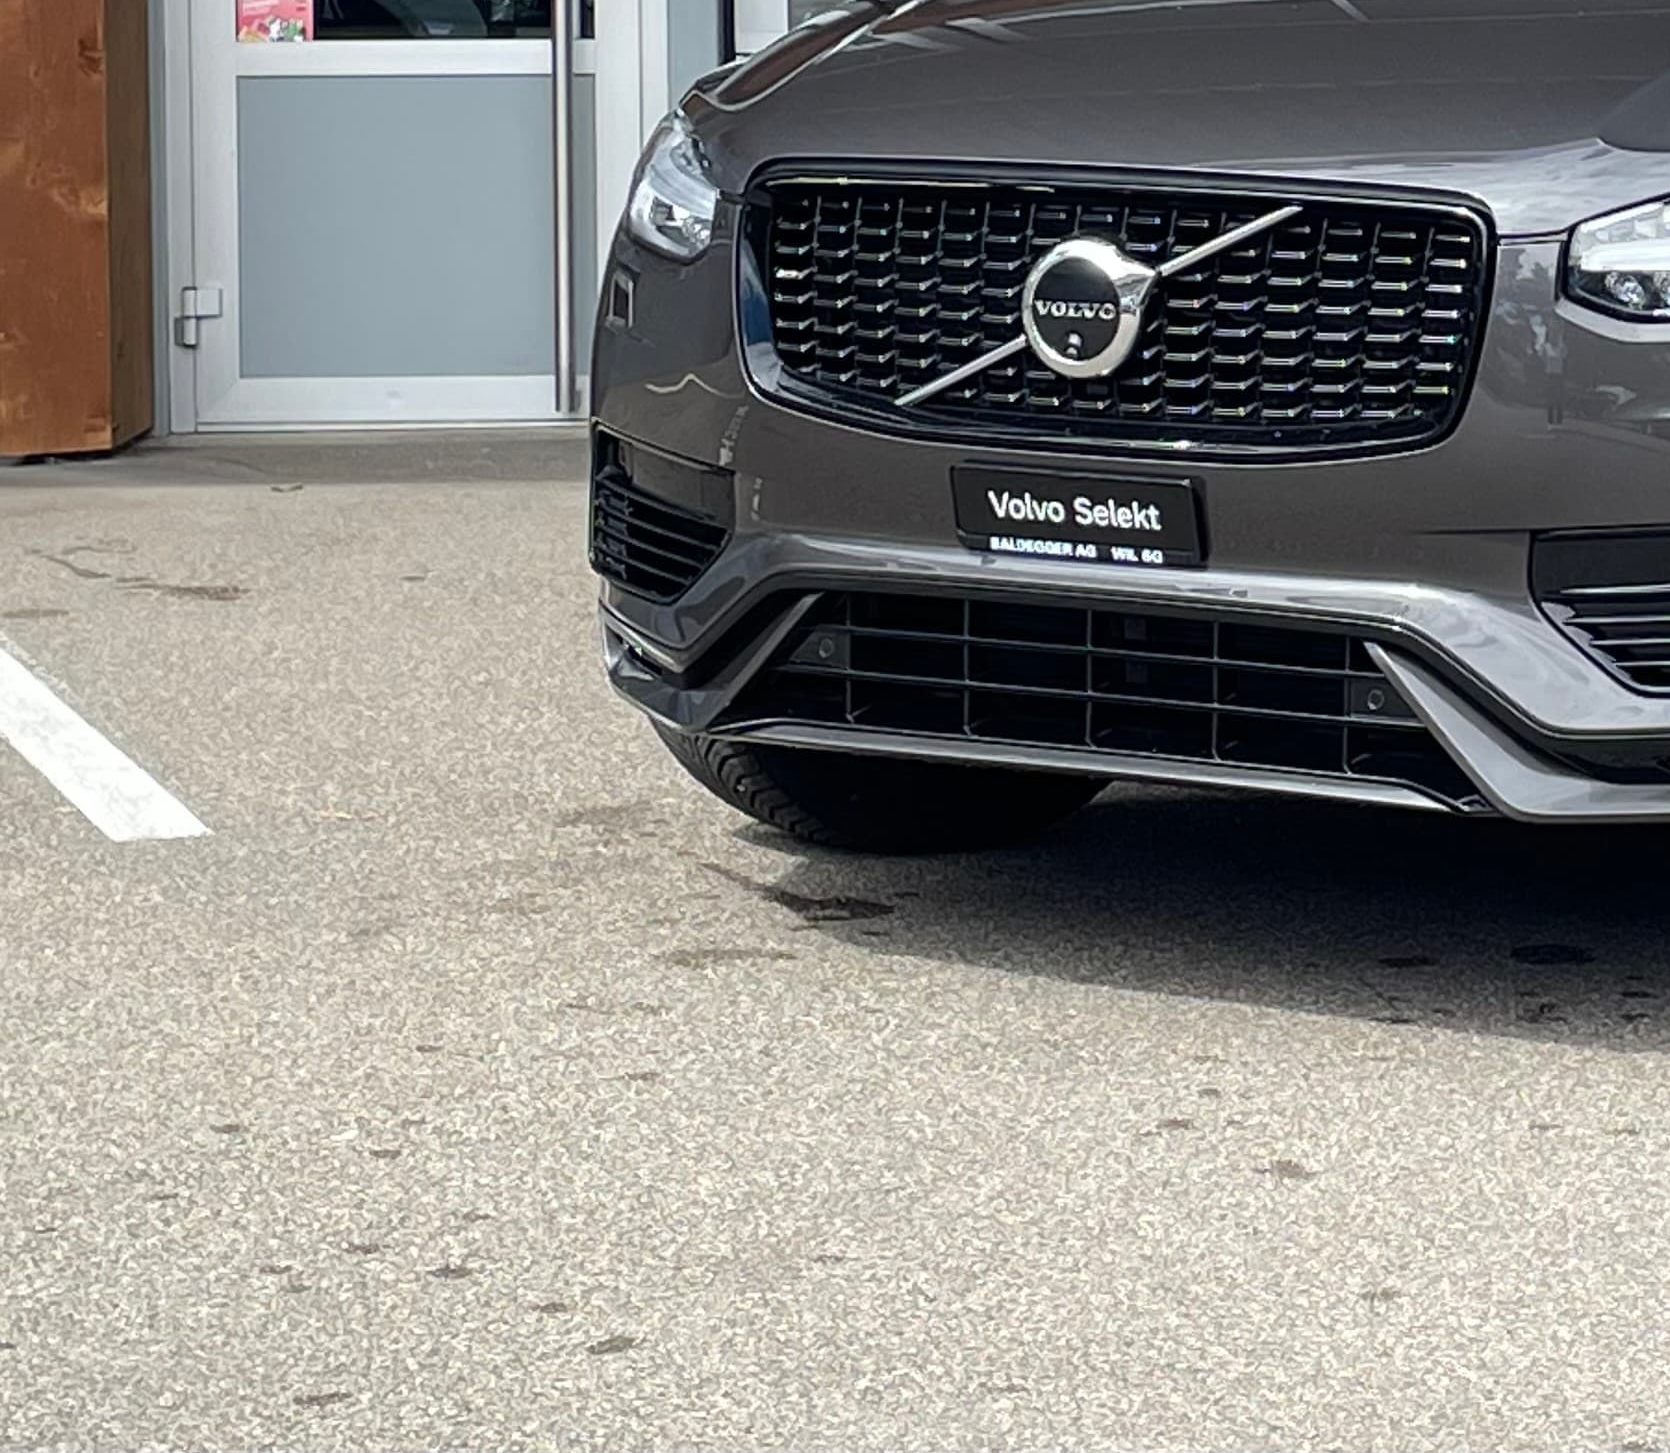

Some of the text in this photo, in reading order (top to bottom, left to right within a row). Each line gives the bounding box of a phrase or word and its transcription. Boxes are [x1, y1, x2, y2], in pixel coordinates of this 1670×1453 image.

[1034, 300, 1117, 321] VOLVO
[987, 490, 1162, 531] Volvo Selekt
[989, 536, 1073, 557] BALDEGGER
[1075, 543, 1097, 559] AG
